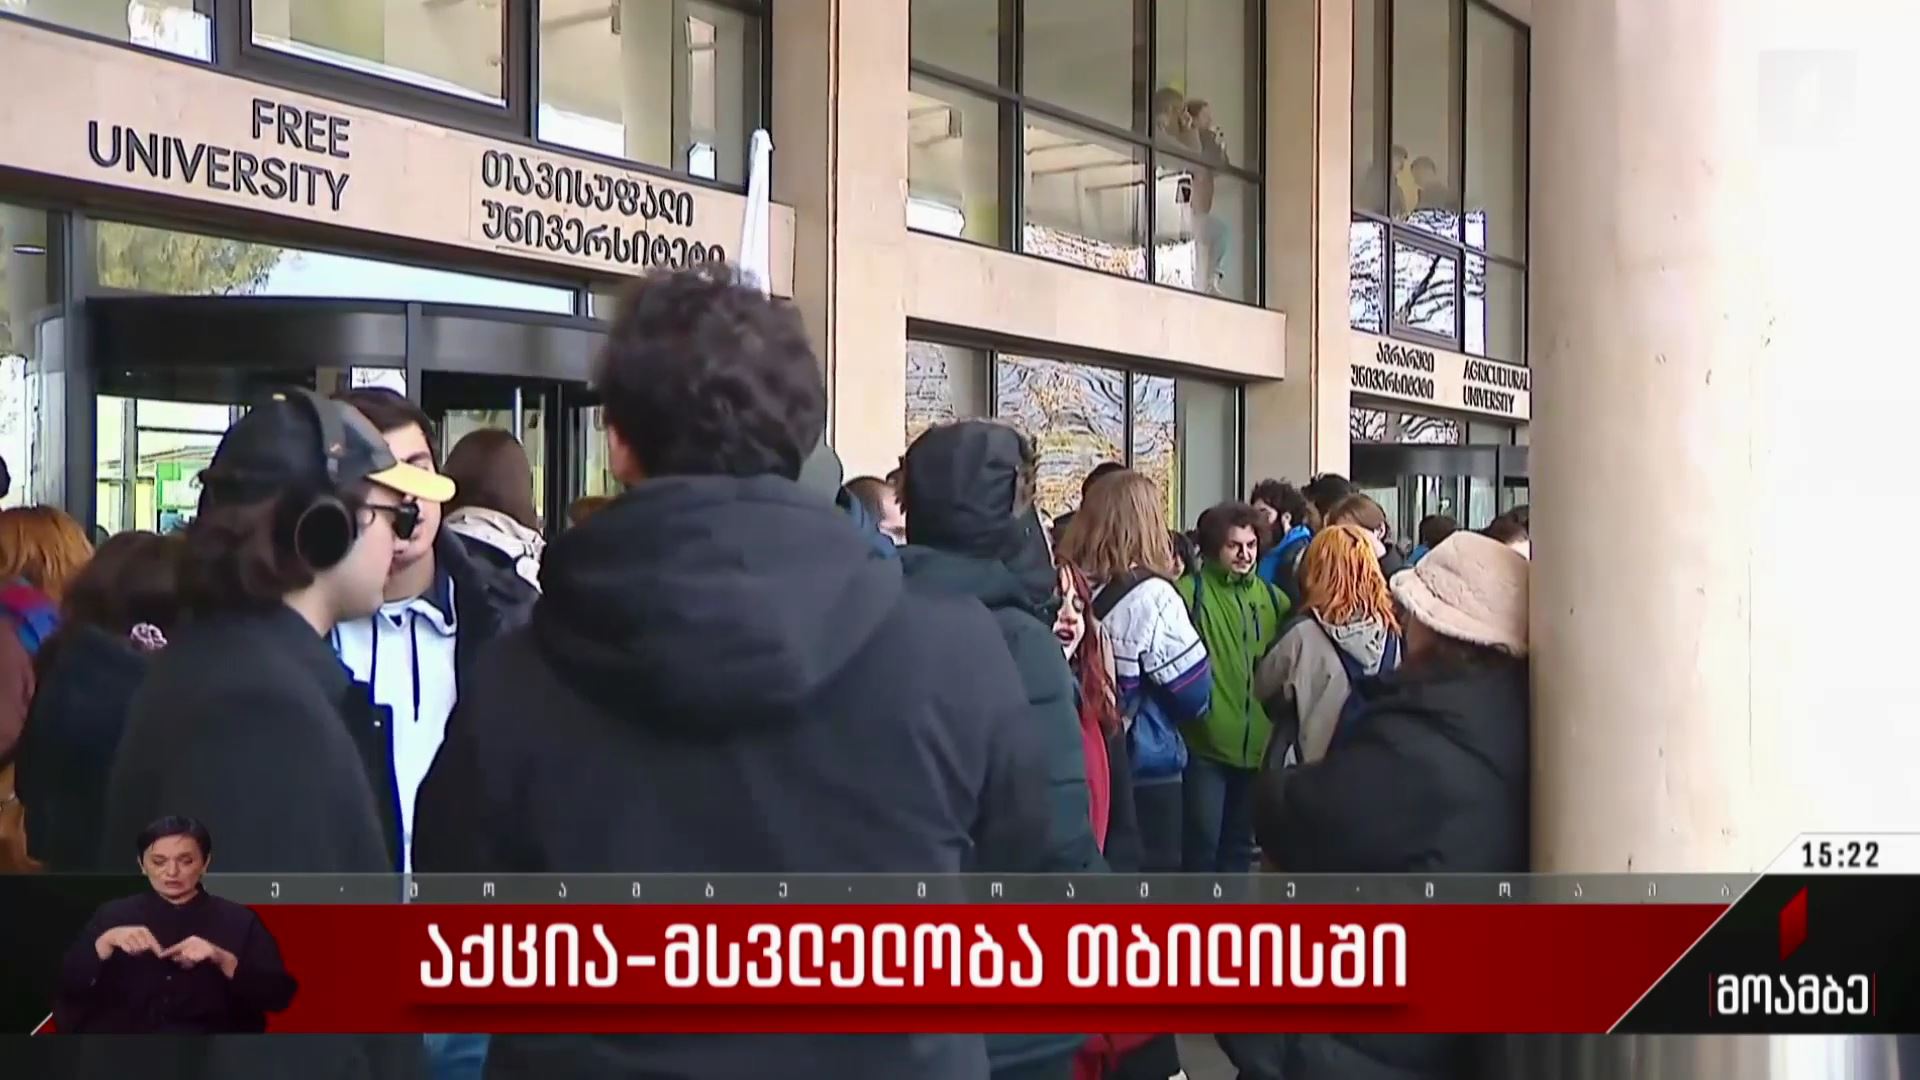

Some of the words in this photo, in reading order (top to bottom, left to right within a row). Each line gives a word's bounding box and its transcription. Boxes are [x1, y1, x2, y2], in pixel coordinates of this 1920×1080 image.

[252, 98, 350, 159] FREE
[88, 120, 350, 211] UNIVERSITY
[482, 150, 695, 227] თავისუფალი
[1463, 359, 1530, 391] AGRICULTURAL
[1463, 385, 1515, 414] UNIVERSITY
